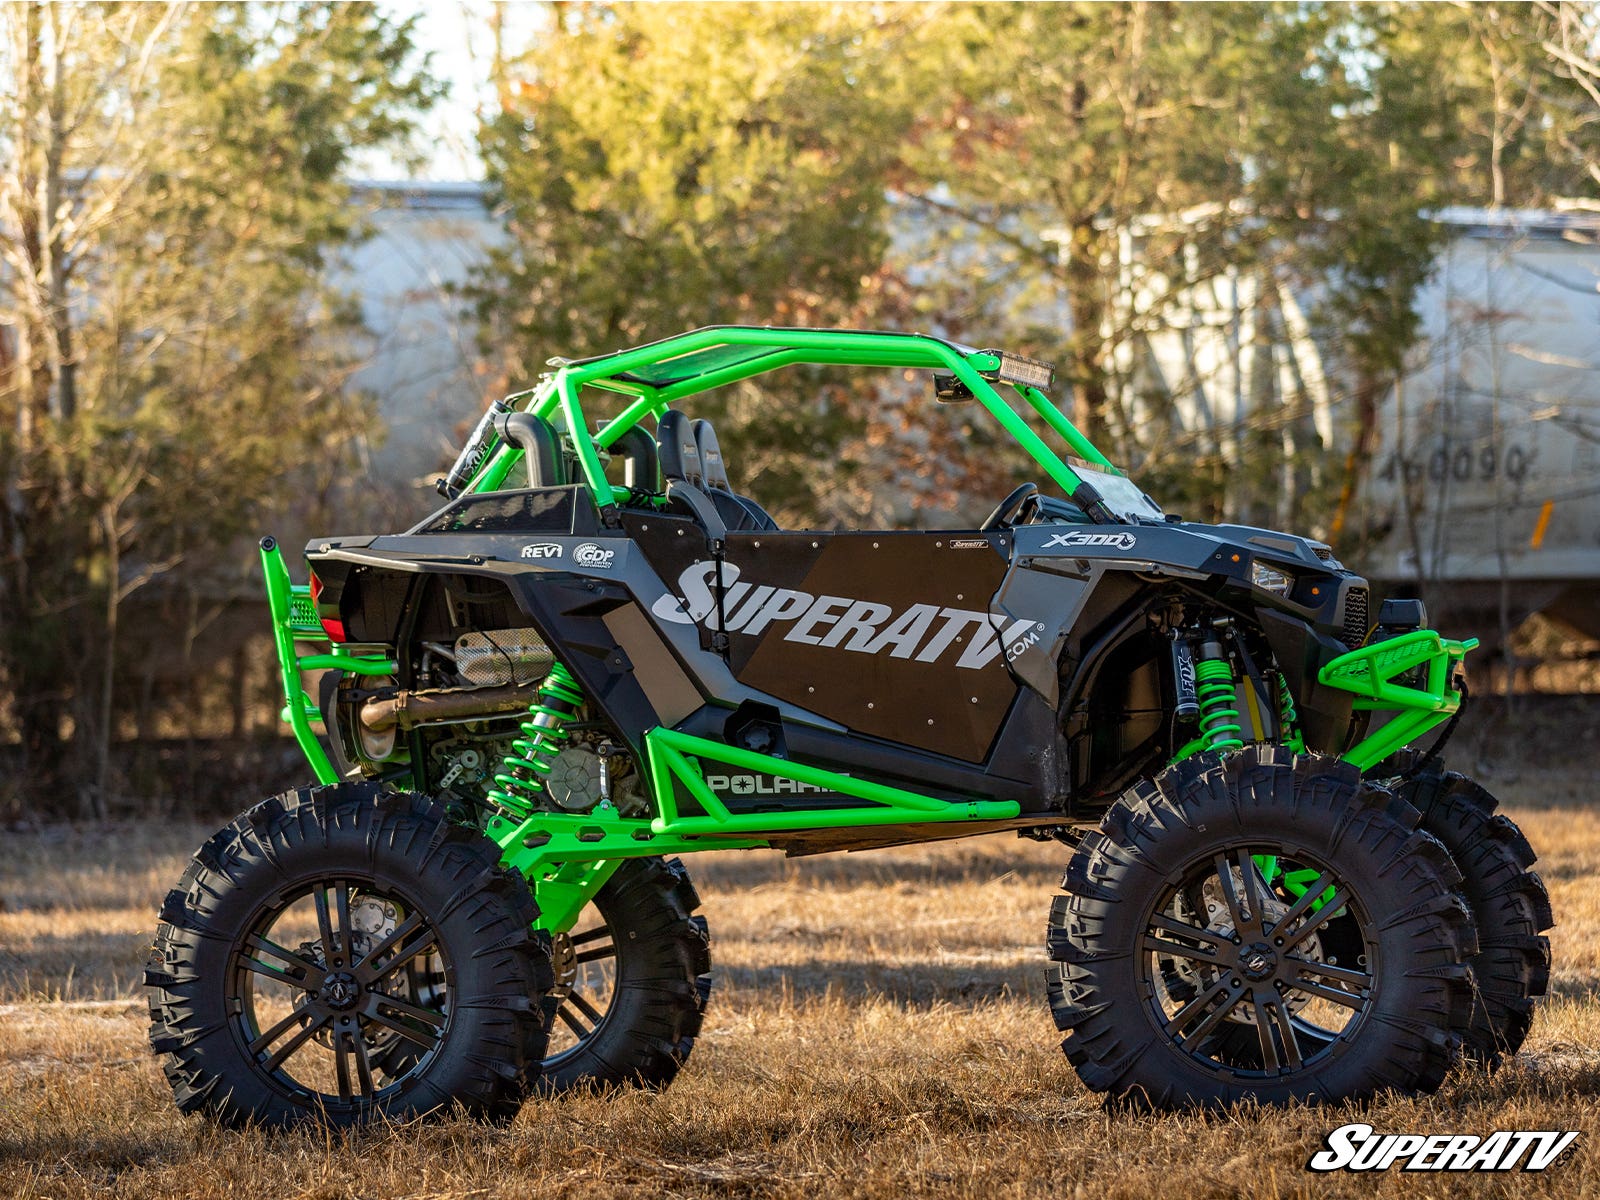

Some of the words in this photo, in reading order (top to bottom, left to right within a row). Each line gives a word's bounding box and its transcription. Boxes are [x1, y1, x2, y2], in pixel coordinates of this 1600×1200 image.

[1040, 531, 1121, 548] X300
[581, 550, 614, 561] GDP
[651, 560, 1037, 671] SUPERATV
[1177, 655, 1196, 694] FOX
[706, 773, 850, 794] POLA
